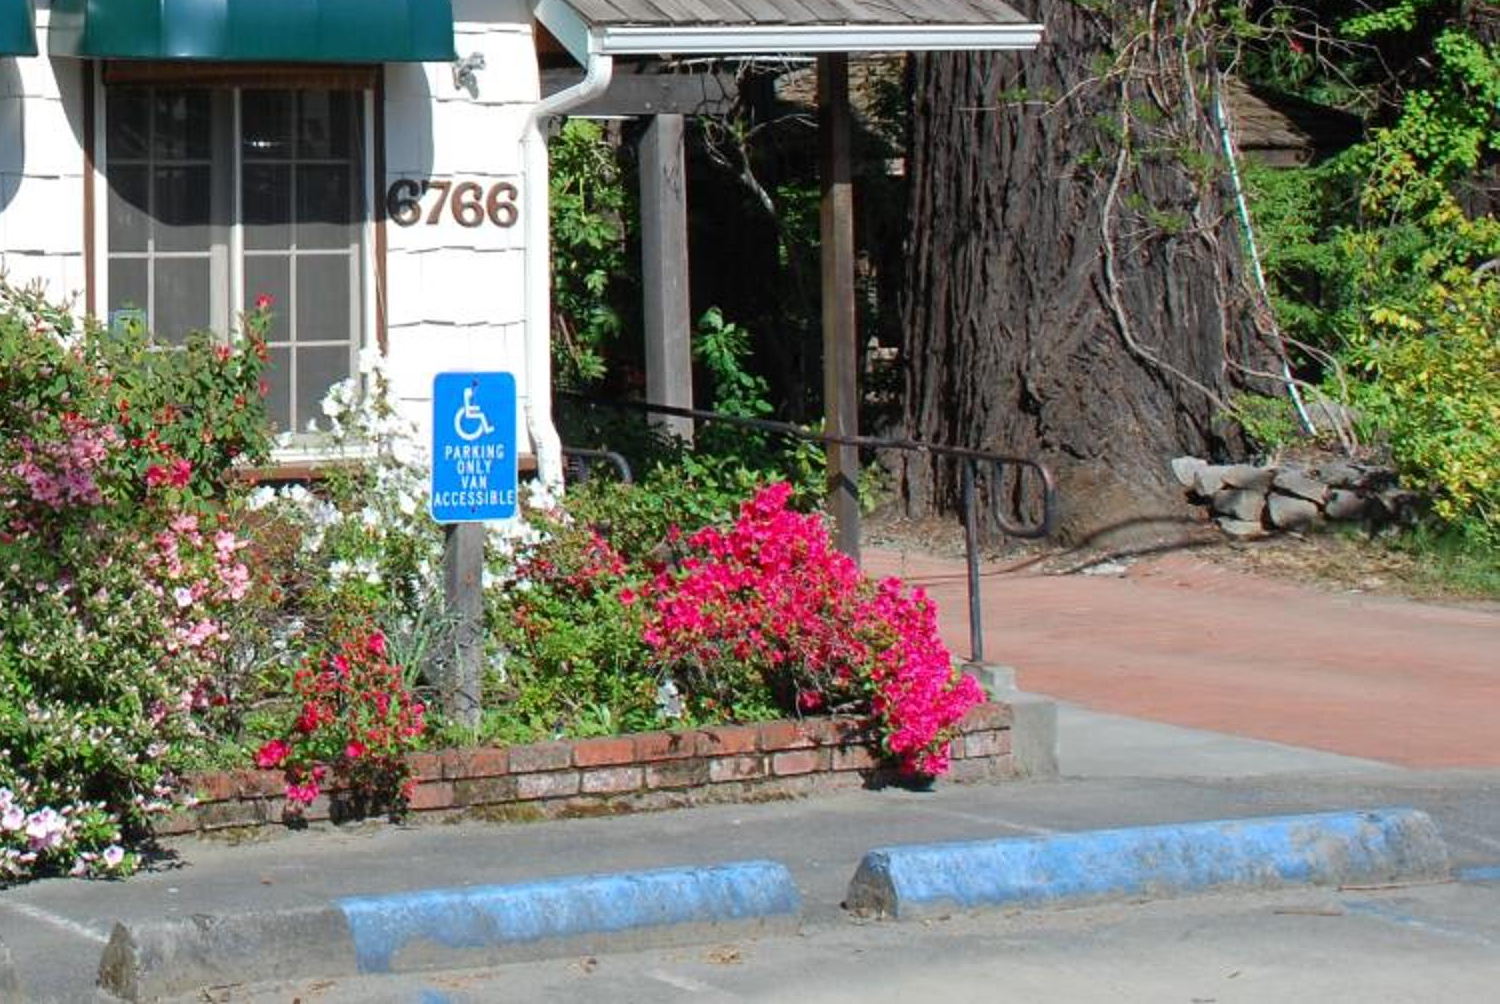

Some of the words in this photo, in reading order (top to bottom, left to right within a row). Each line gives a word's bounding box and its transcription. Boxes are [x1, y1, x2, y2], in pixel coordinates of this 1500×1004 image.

[387, 178, 519, 228] 6766
[444, 444, 505, 460] PARKING
[457, 459, 492, 474] ONLY
[461, 475, 487, 489] VAN
[433, 490, 514, 507] ACCESSIBLE
